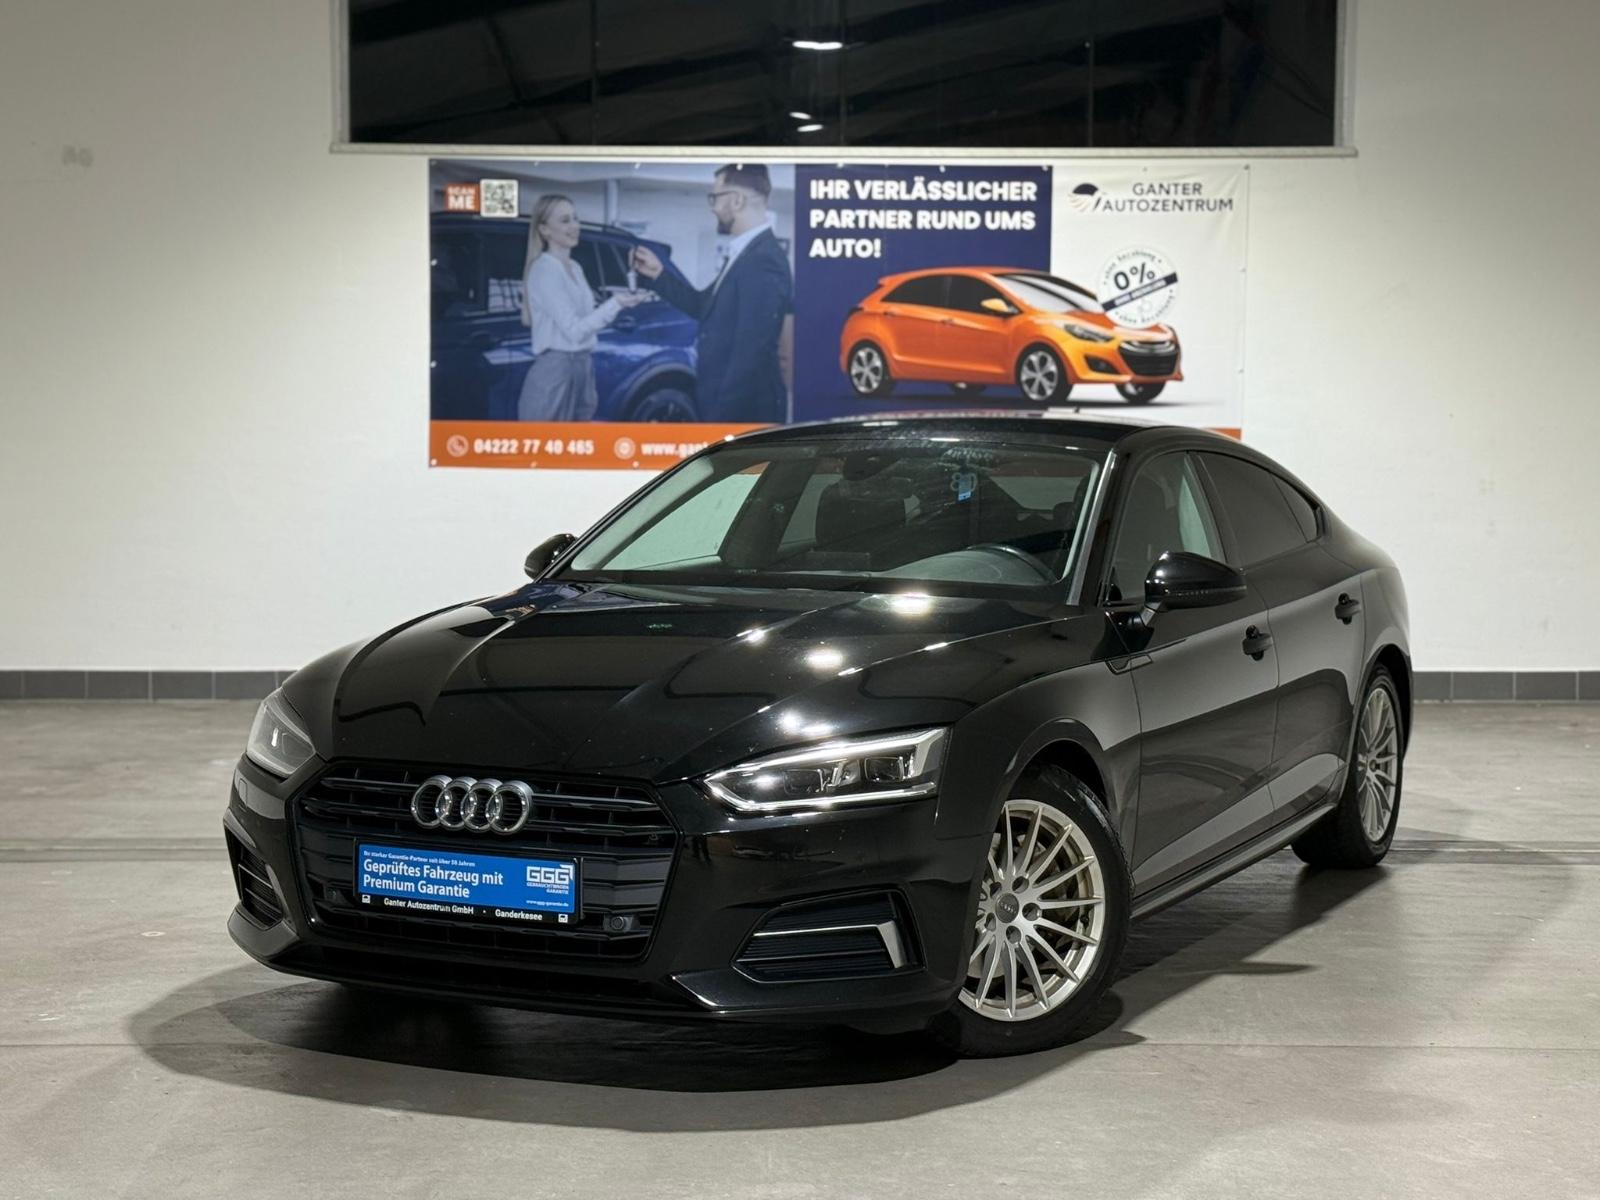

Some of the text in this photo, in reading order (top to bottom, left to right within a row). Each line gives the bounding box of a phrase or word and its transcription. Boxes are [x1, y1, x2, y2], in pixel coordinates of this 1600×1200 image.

[809, 176, 1038, 202] IHR VERLÄSSLICHER
[1132, 182, 1203, 196] GANTER
[447, 195, 476, 210] ME
[1102, 198, 1234, 212] AUTOZENTRUM
[809, 209, 1036, 230] PARTNER RUND UMS
[808, 238, 882, 258] AUTO!
[1113, 262, 1156, 291] 0%
[473, 439, 519, 455] 04222
[523, 439, 541, 455] 77
[567, 439, 594, 456] 465
[363, 859, 504, 886] Geprüftes Fahrzeug mit
[526, 865, 571, 885] GGG
[363, 874, 470, 898] Premium Garantie
[383, 897, 474, 915] Ganter Autozentrum GmbH
[495, 909, 543, 921] Ganderkesee
